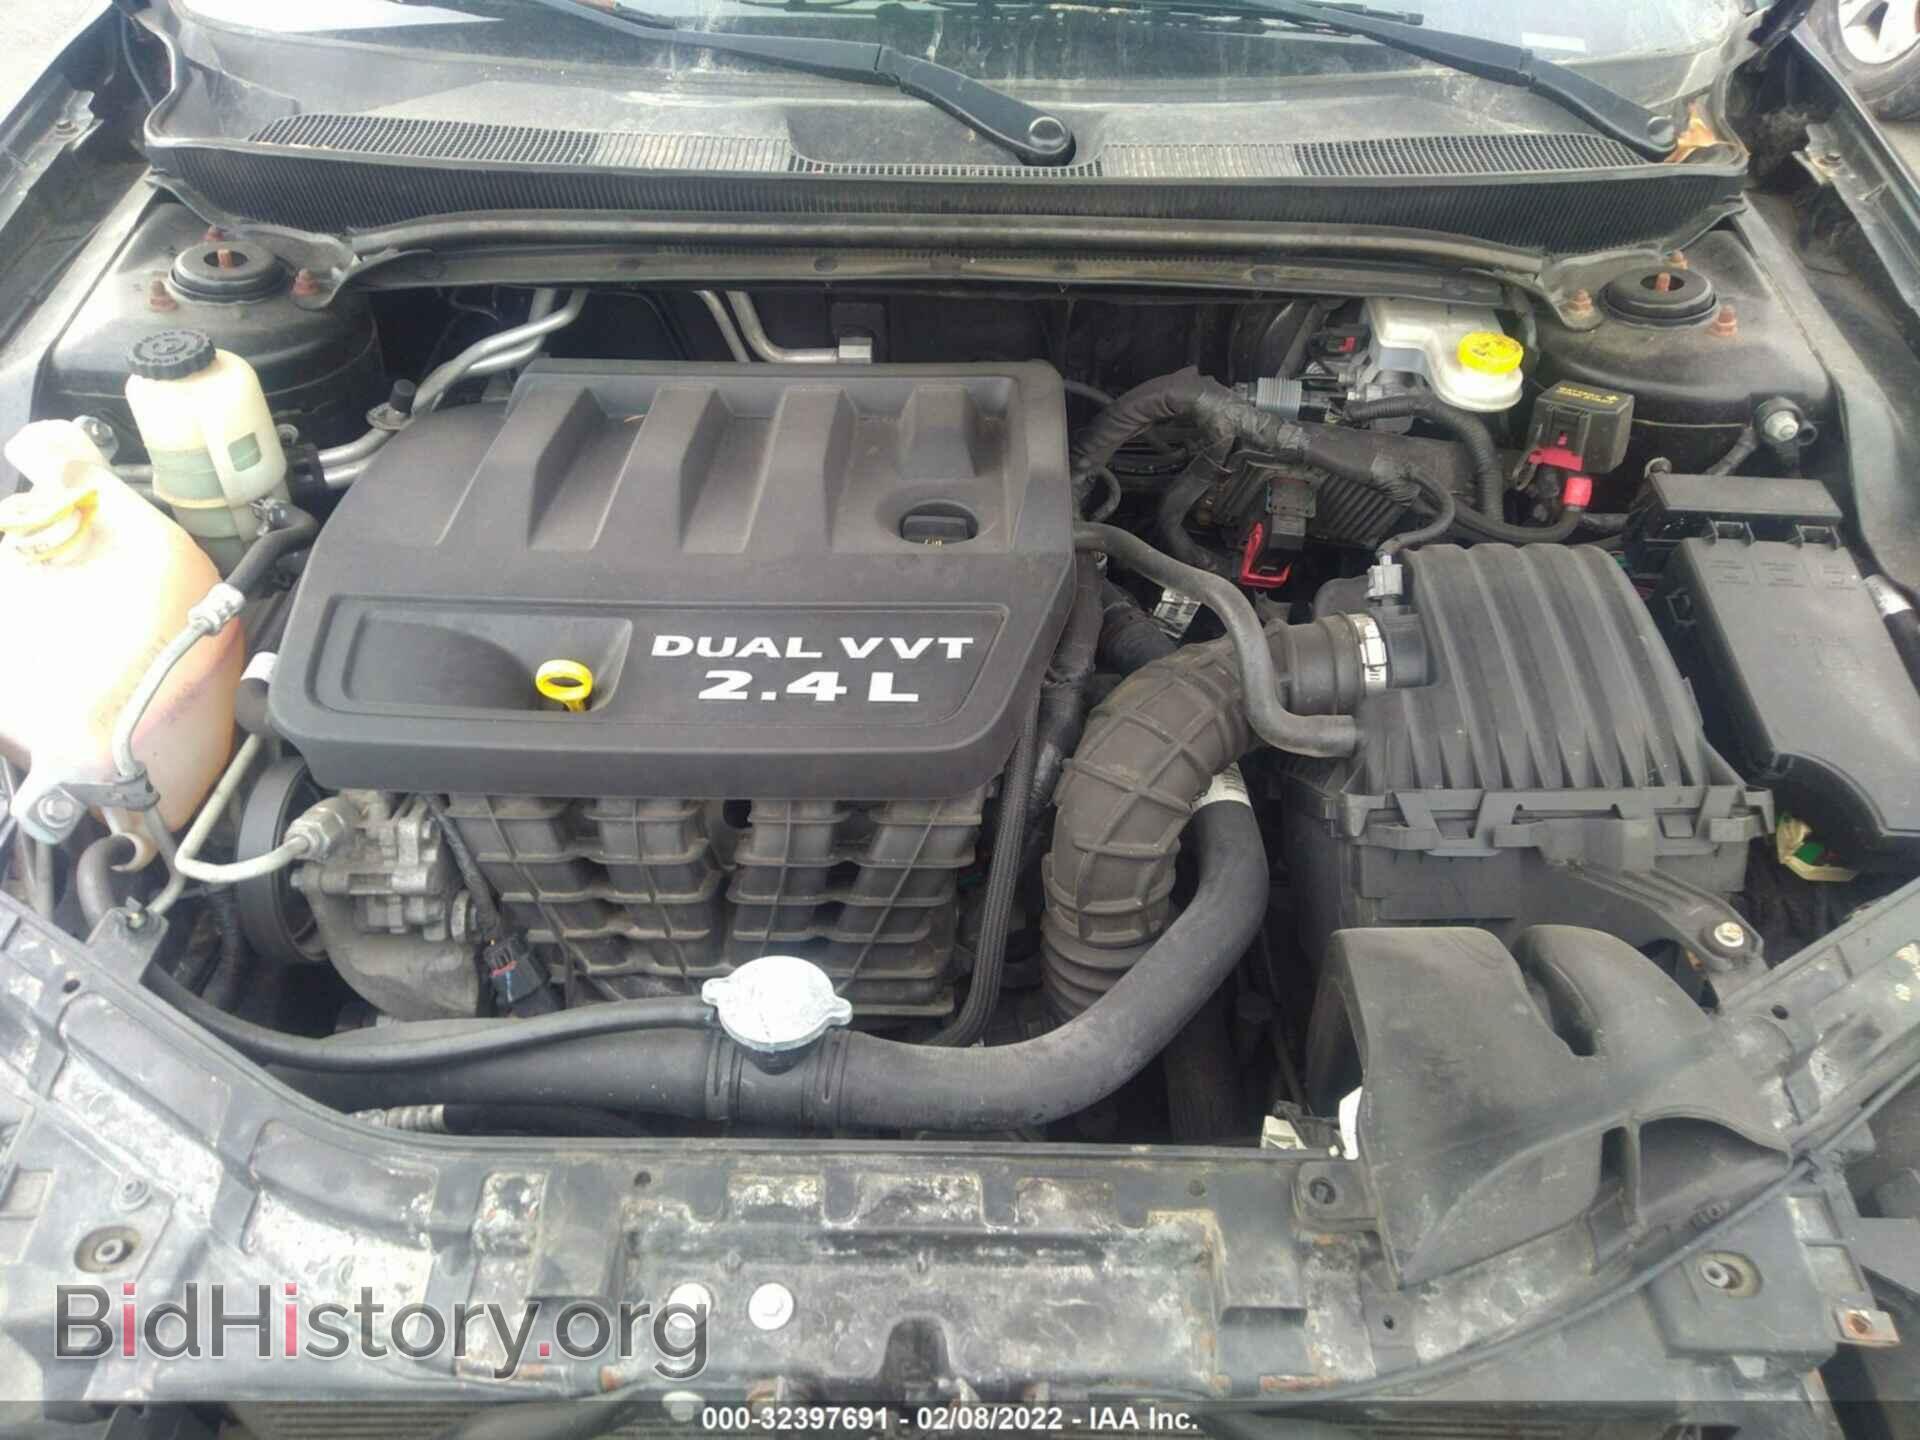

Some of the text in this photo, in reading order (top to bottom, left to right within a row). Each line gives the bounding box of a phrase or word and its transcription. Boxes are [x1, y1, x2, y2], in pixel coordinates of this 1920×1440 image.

[651, 635, 974, 659] DUAL VVT
[698, 669, 919, 702] 2.4 L
